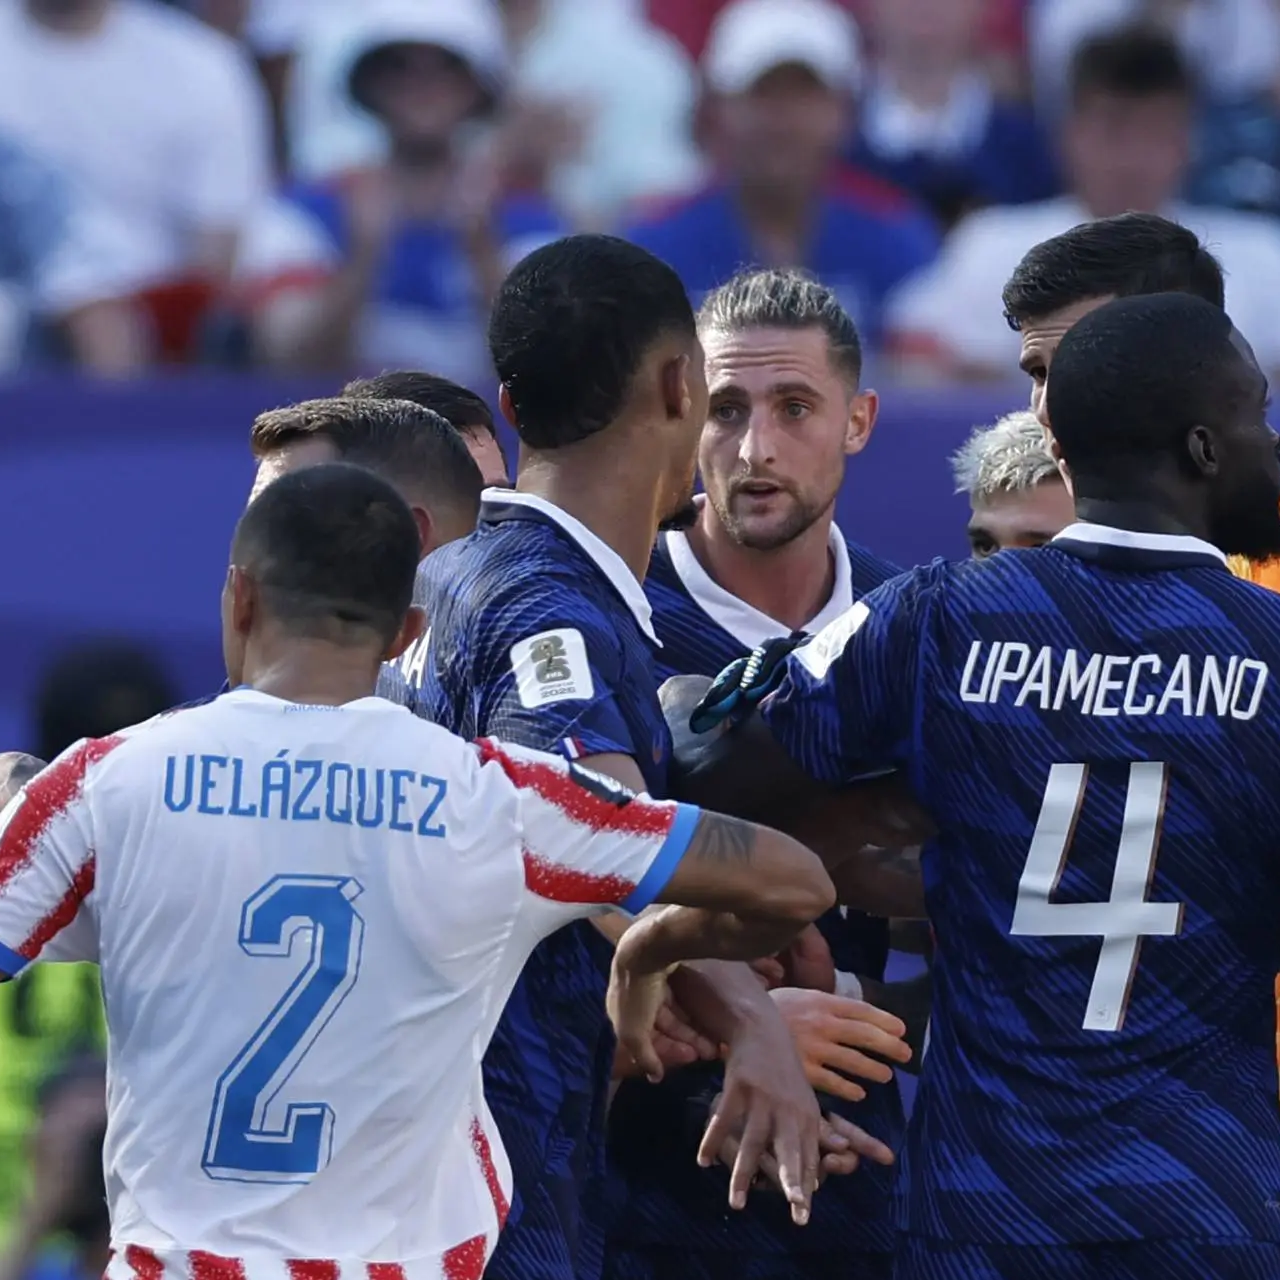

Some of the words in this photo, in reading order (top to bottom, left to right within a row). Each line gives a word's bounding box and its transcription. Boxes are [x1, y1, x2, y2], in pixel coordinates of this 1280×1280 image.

[959, 640, 1269, 721] UPAMECANO
[164, 748, 448, 838] VELÁZQUEZ
[1010, 761, 1185, 1031] 4
[200, 873, 365, 1184] 2
